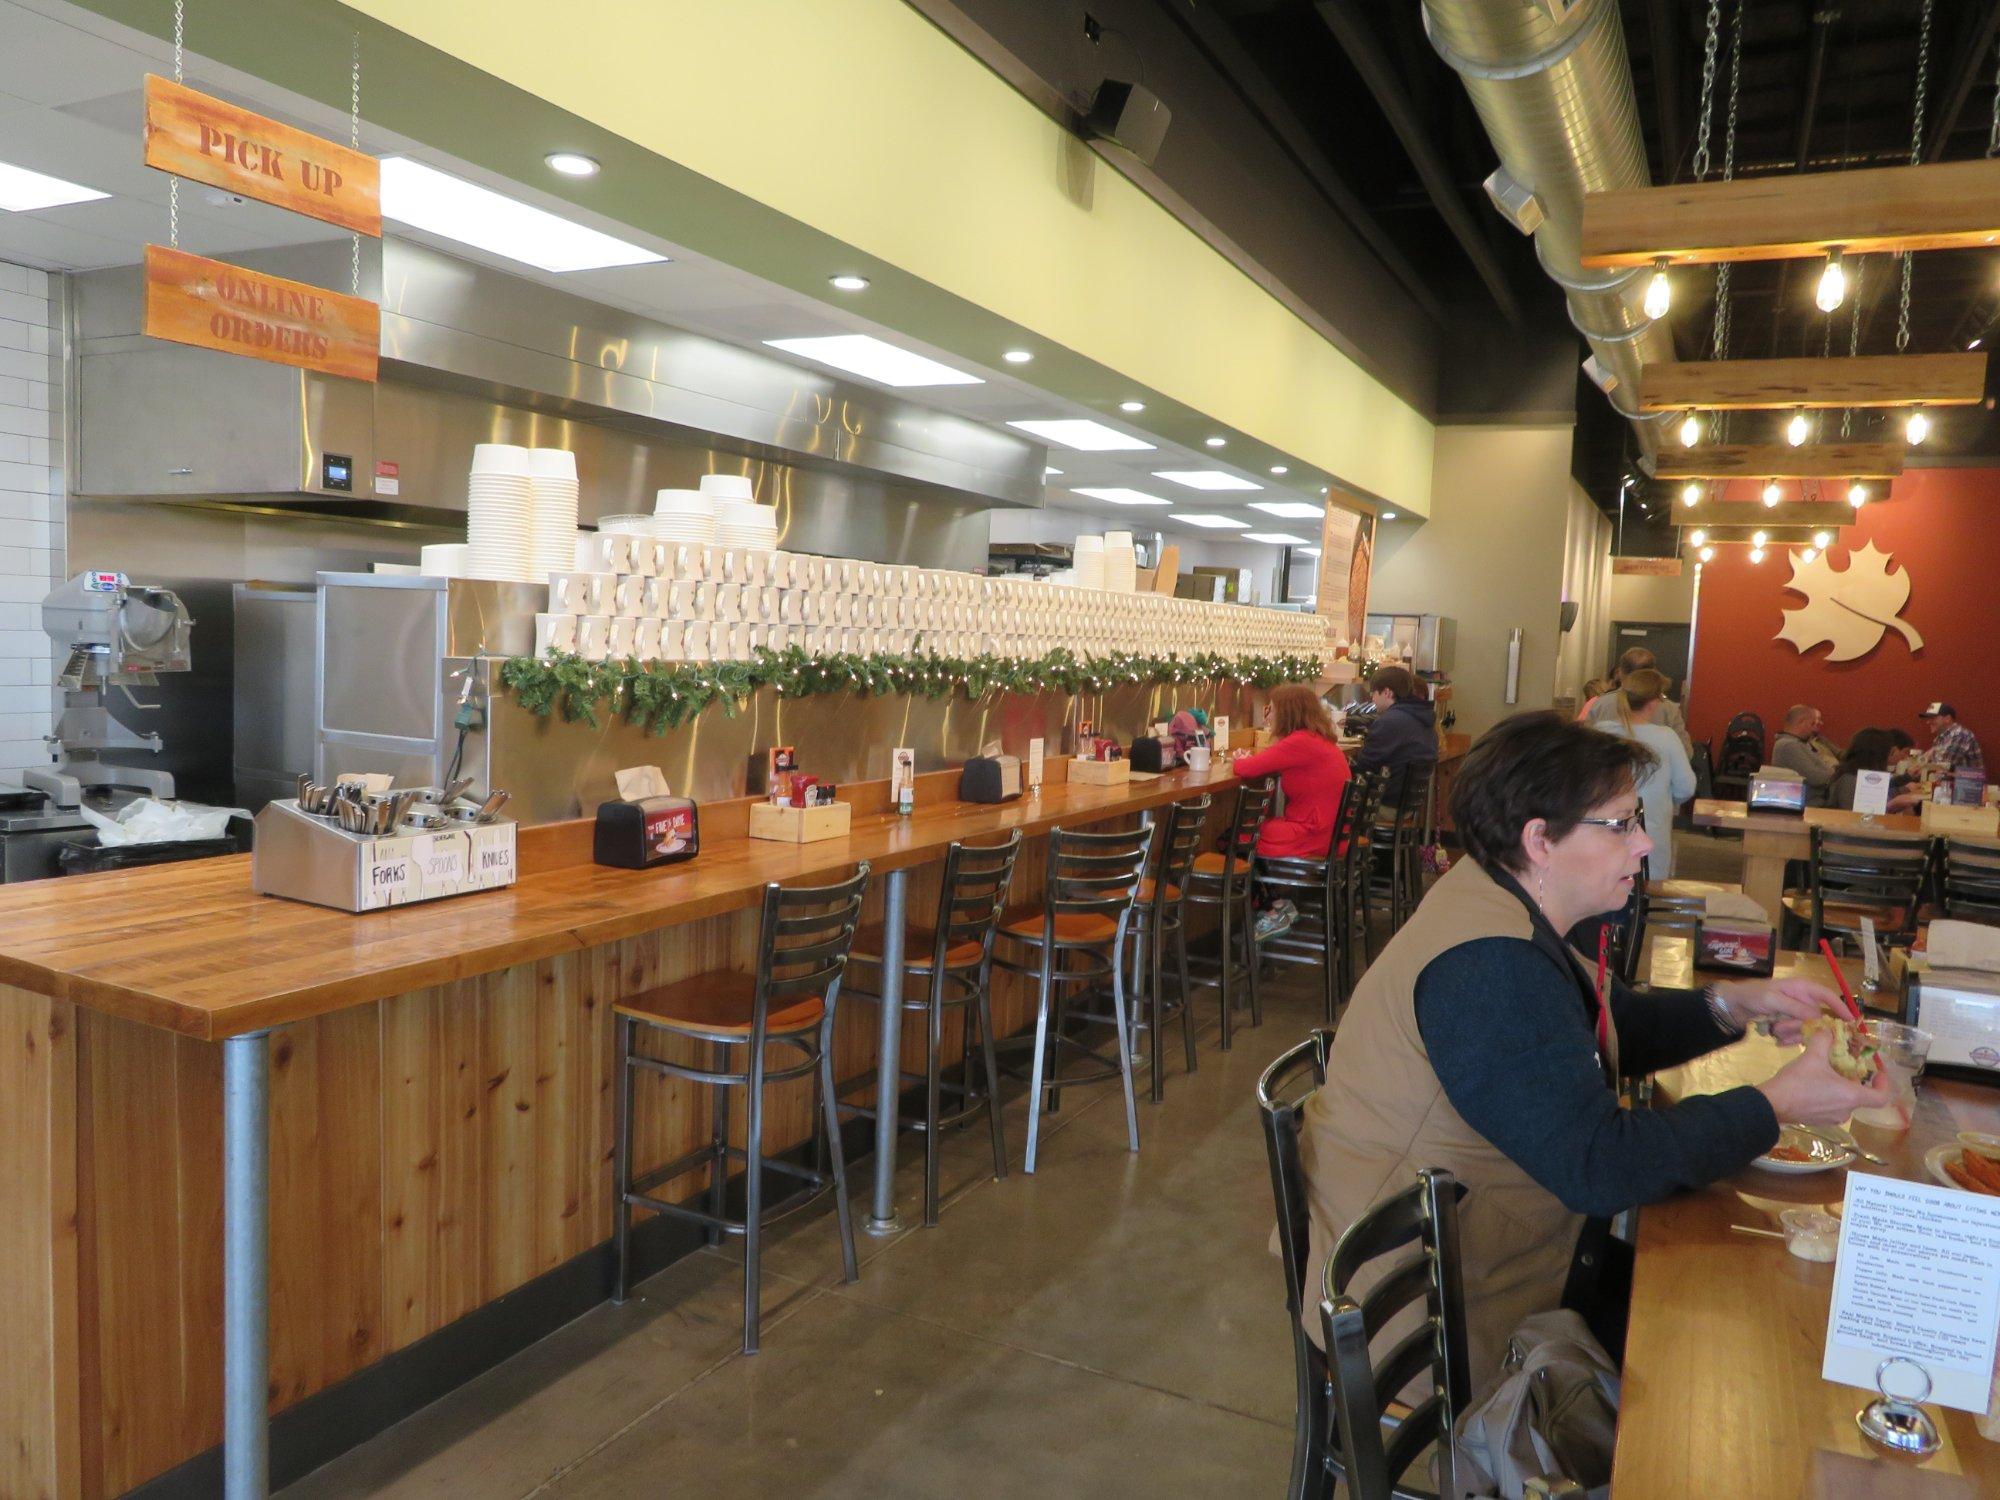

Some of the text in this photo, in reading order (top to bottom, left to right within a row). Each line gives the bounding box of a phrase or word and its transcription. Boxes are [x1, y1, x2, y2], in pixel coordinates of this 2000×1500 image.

[200, 122, 343, 198] PICK UP
[215, 271, 326, 323] ONLINE
[209, 312, 330, 360] ORDERS
[372, 864, 406, 886] FORKS
[427, 854, 458, 876] SPOONS
